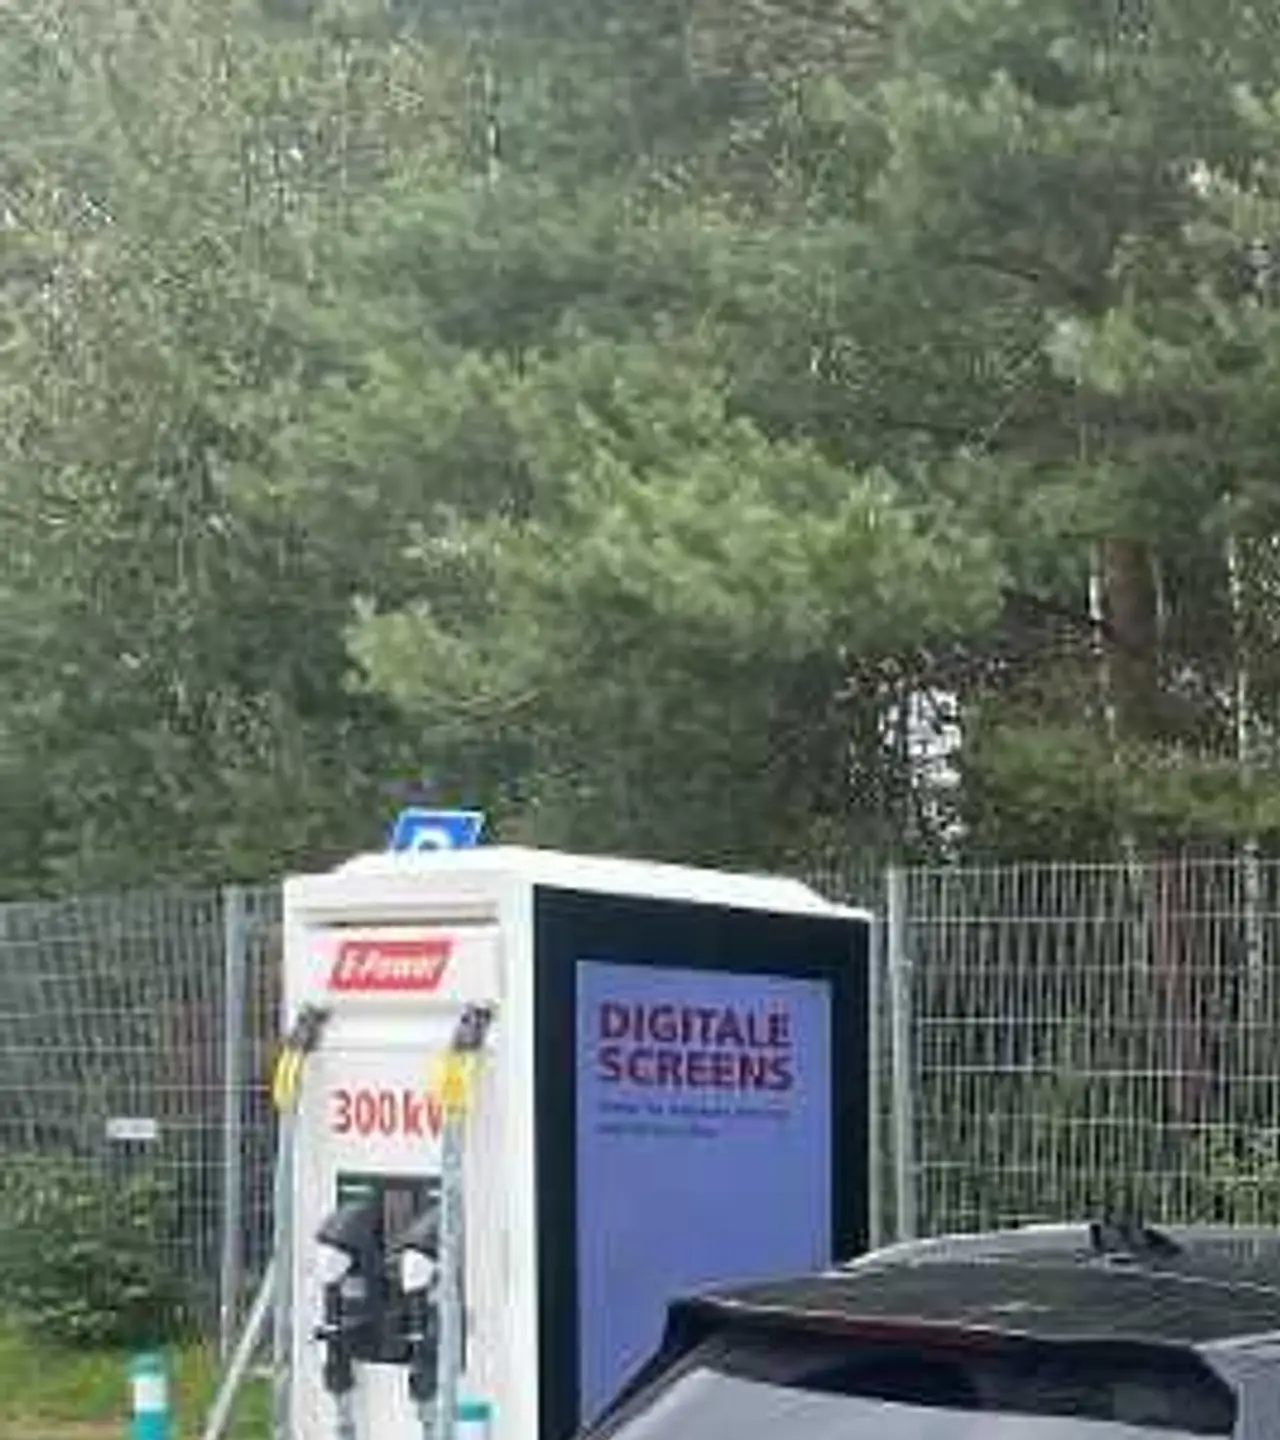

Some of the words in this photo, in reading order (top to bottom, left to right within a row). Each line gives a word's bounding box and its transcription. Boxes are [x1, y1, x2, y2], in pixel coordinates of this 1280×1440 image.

[599, 999, 794, 1049] DIGITALE
[597, 1047, 794, 1091] SCREENS
[331, 1089, 398, 1135] 300
